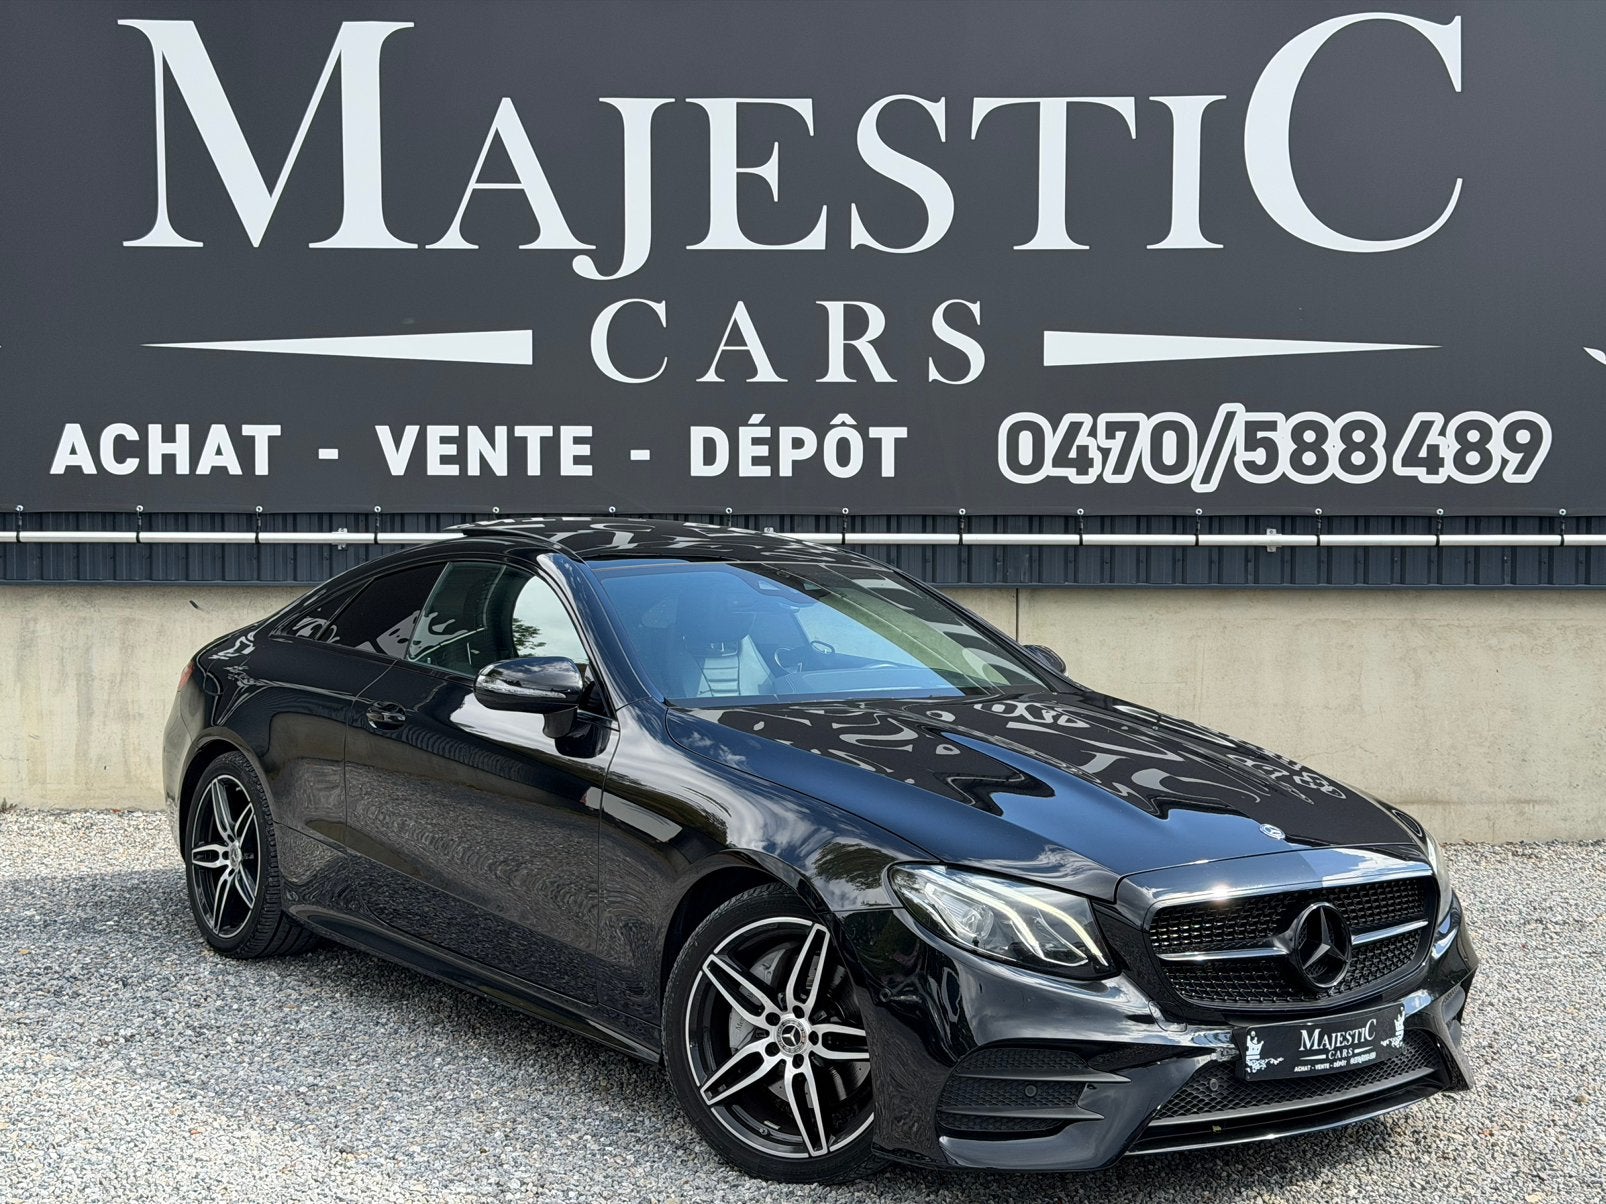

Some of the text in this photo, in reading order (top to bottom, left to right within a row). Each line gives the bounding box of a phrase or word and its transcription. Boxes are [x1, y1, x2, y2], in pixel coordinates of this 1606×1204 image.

[118, 12, 1463, 280] MAJESTIC
[590, 298, 986, 385] CARS
[50, 403, 1552, 493] ACHAT - VENTE - DÉPÔT 0470/588 489
[1298, 1018, 1377, 1051] MAJESTIC
[1328, 1047, 1353, 1060] CARS
